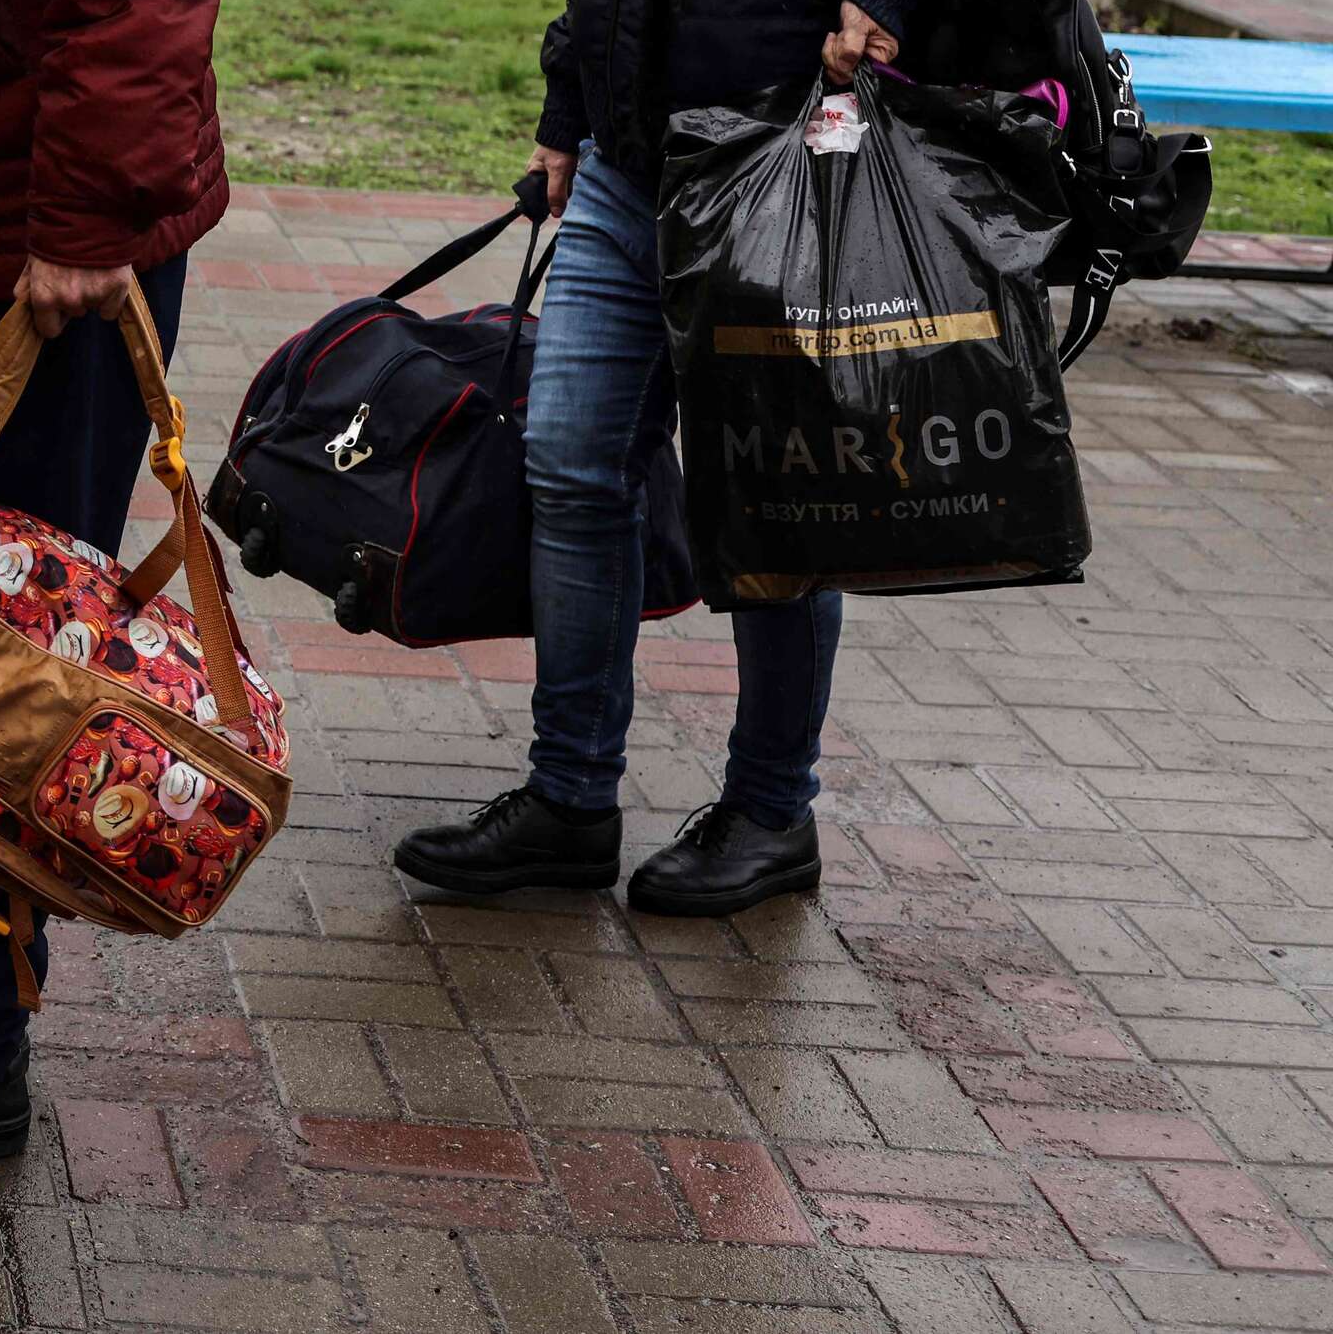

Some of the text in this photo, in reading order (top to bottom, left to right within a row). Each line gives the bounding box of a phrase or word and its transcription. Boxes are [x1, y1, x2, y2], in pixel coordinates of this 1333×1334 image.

[837, 296, 920, 321] ОНЛАЙН
[760, 493, 991, 523] ВЗУТТЯ СУМКИ
